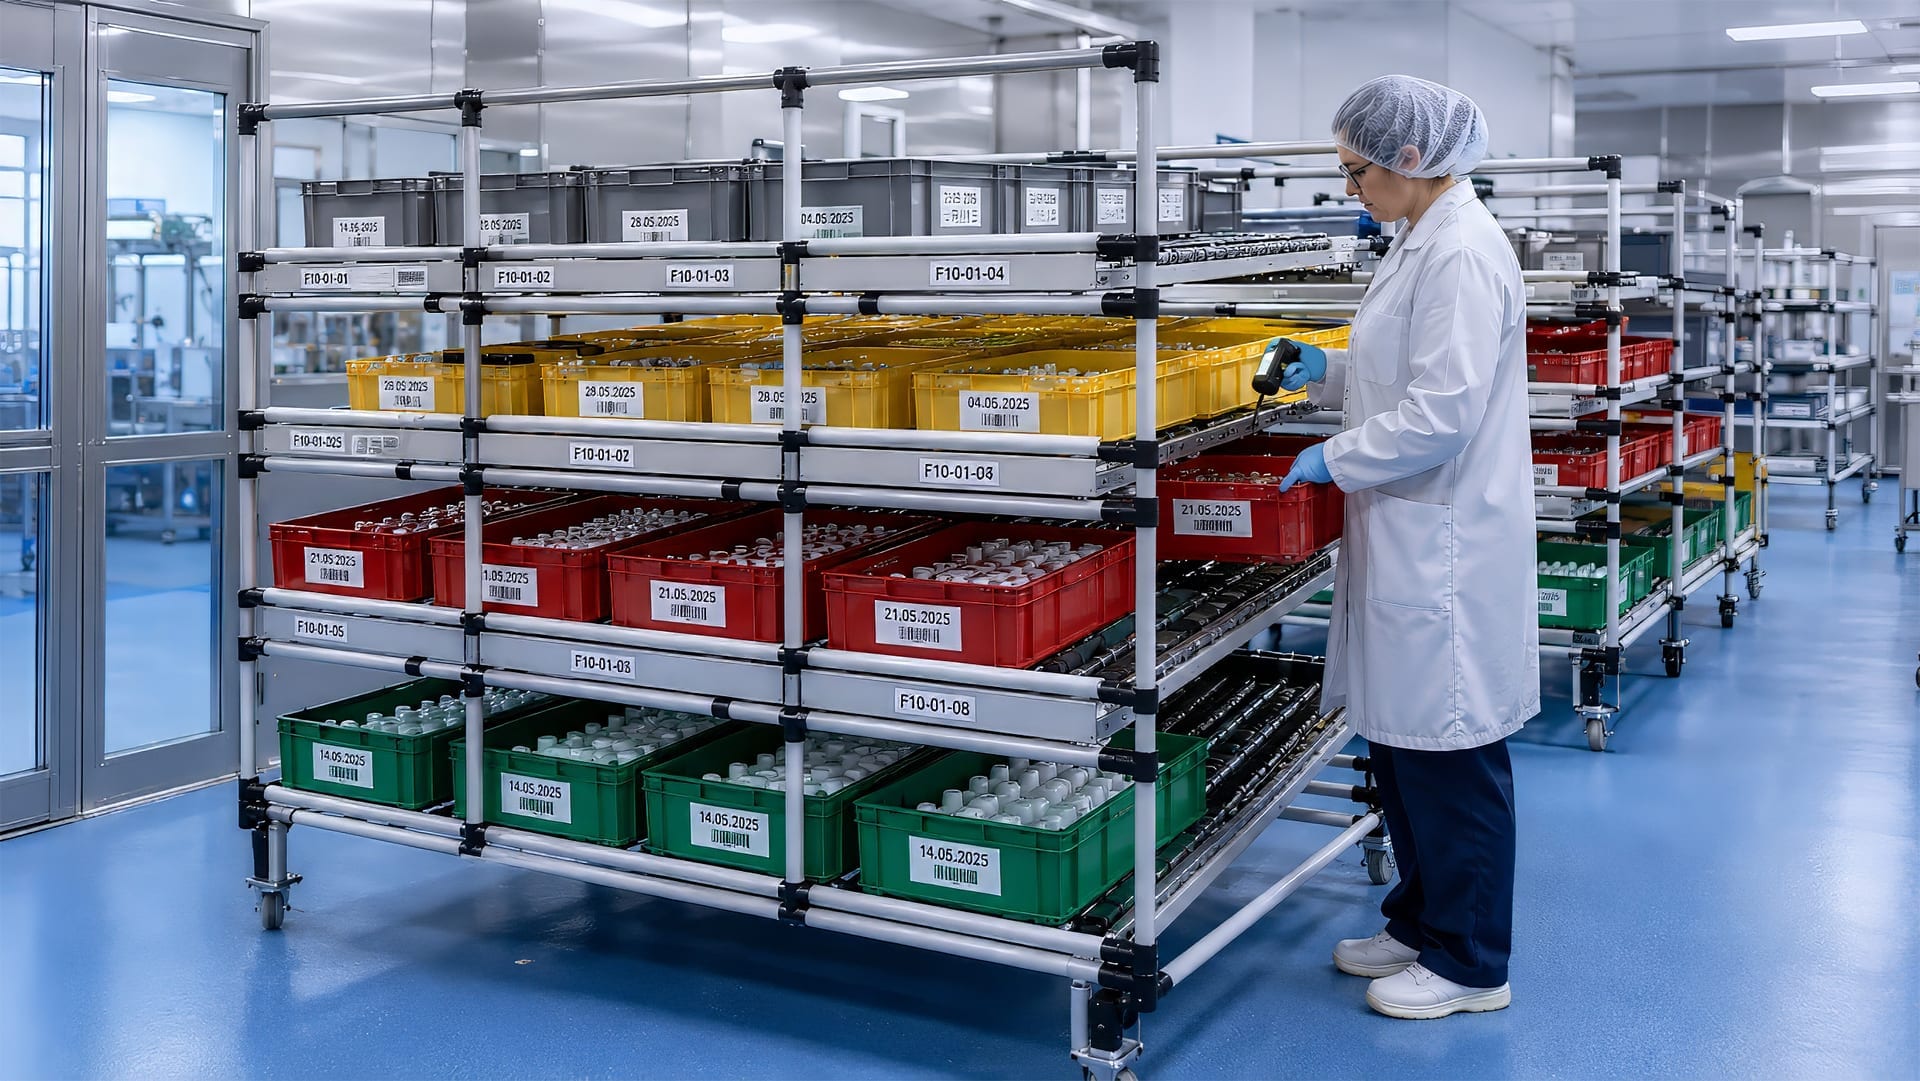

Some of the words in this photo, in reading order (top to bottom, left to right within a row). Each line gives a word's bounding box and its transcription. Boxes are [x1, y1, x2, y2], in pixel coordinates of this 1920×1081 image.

[304, 273, 349, 286] F10-01-01
[498, 271, 551, 284] F10-01-02
[670, 269, 730, 283] F10-01-03
[935, 266, 1005, 281] F10-01-04
[574, 447, 630, 463] F10-01-02
[1181, 504, 1242, 517] 21.05.2025
[484, 569, 530, 585] 1.05.2025
[658, 586, 717, 604] 21.05.2025
[884, 607, 951, 626] 21.05.2025
[900, 693, 970, 716] F10-01-08
[699, 810, 760, 832] 14.05.2025
